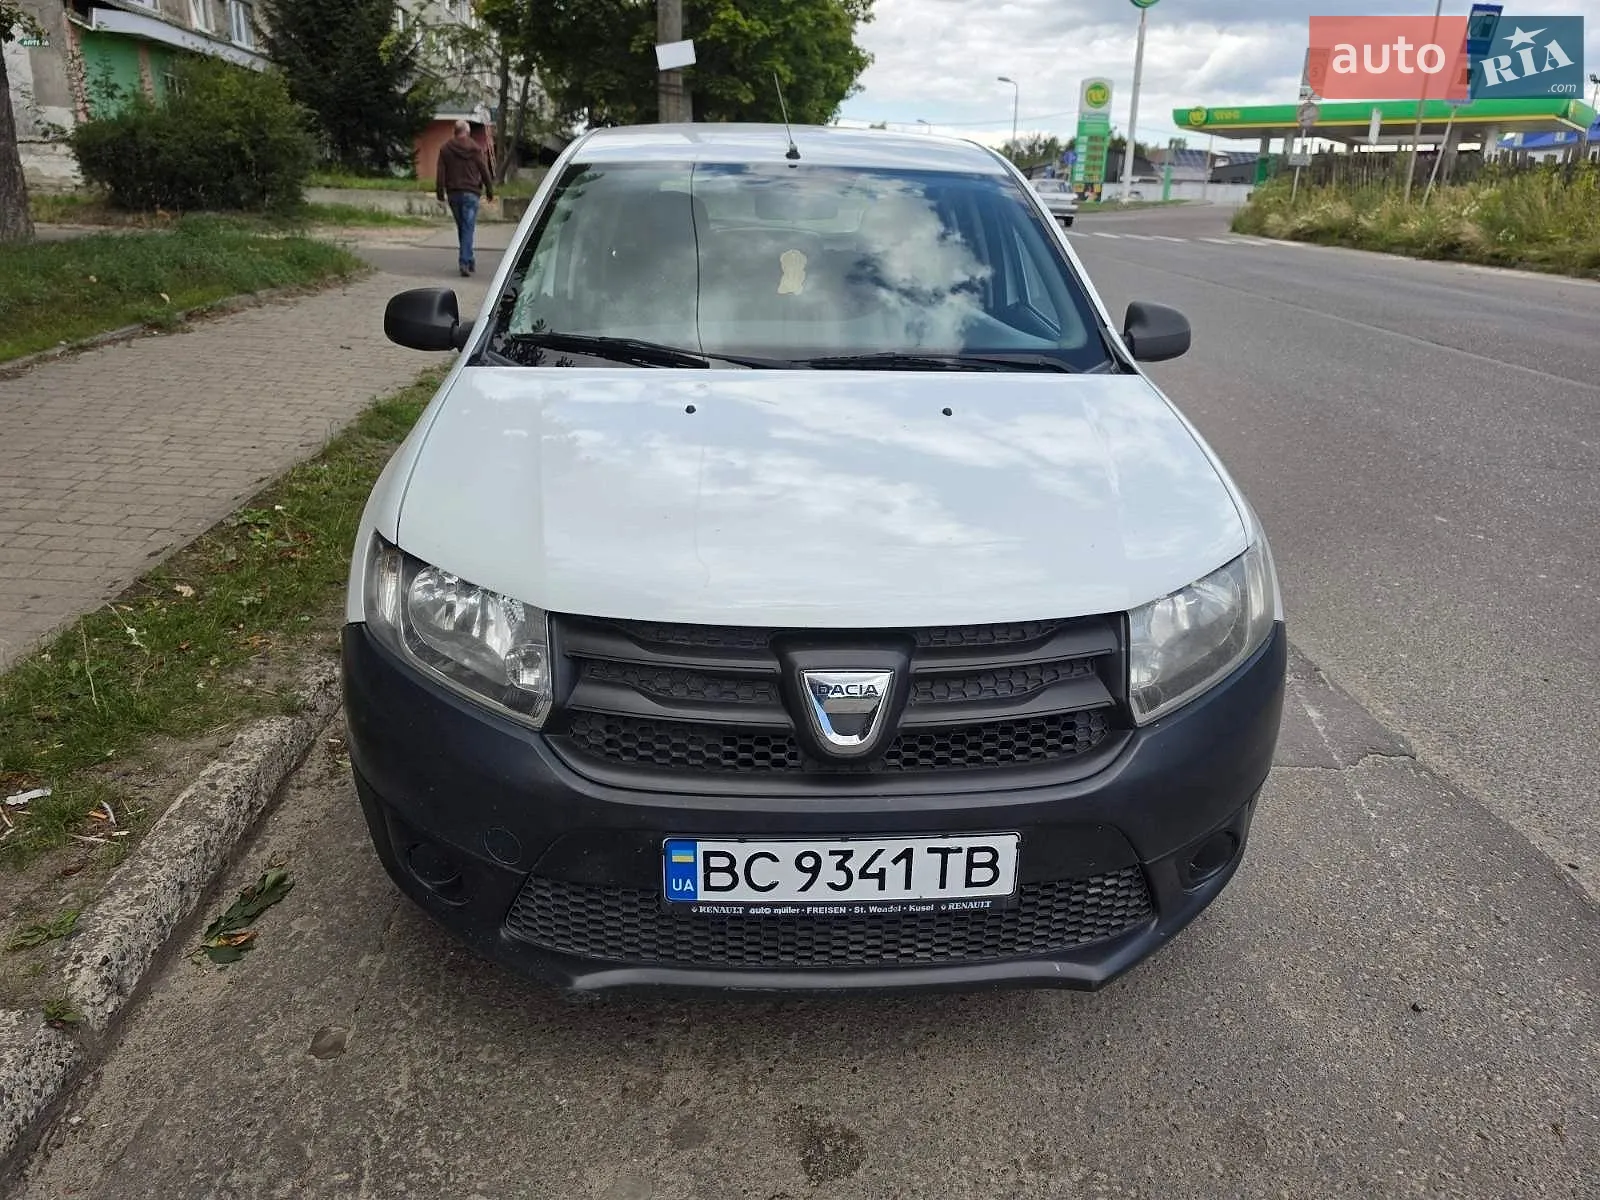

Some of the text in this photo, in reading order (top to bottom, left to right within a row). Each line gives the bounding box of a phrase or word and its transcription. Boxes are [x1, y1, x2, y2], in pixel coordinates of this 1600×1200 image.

[818, 684, 879, 696] DACIA
[702, 846, 1000, 893] BC 9341 TB
[672, 878, 695, 892] UA
[699, 906, 744, 914] RENAULT
[807, 906, 846, 914] FREISEN
[909, 904, 934, 912] Kusel
[948, 901, 992, 910] RENAULT
